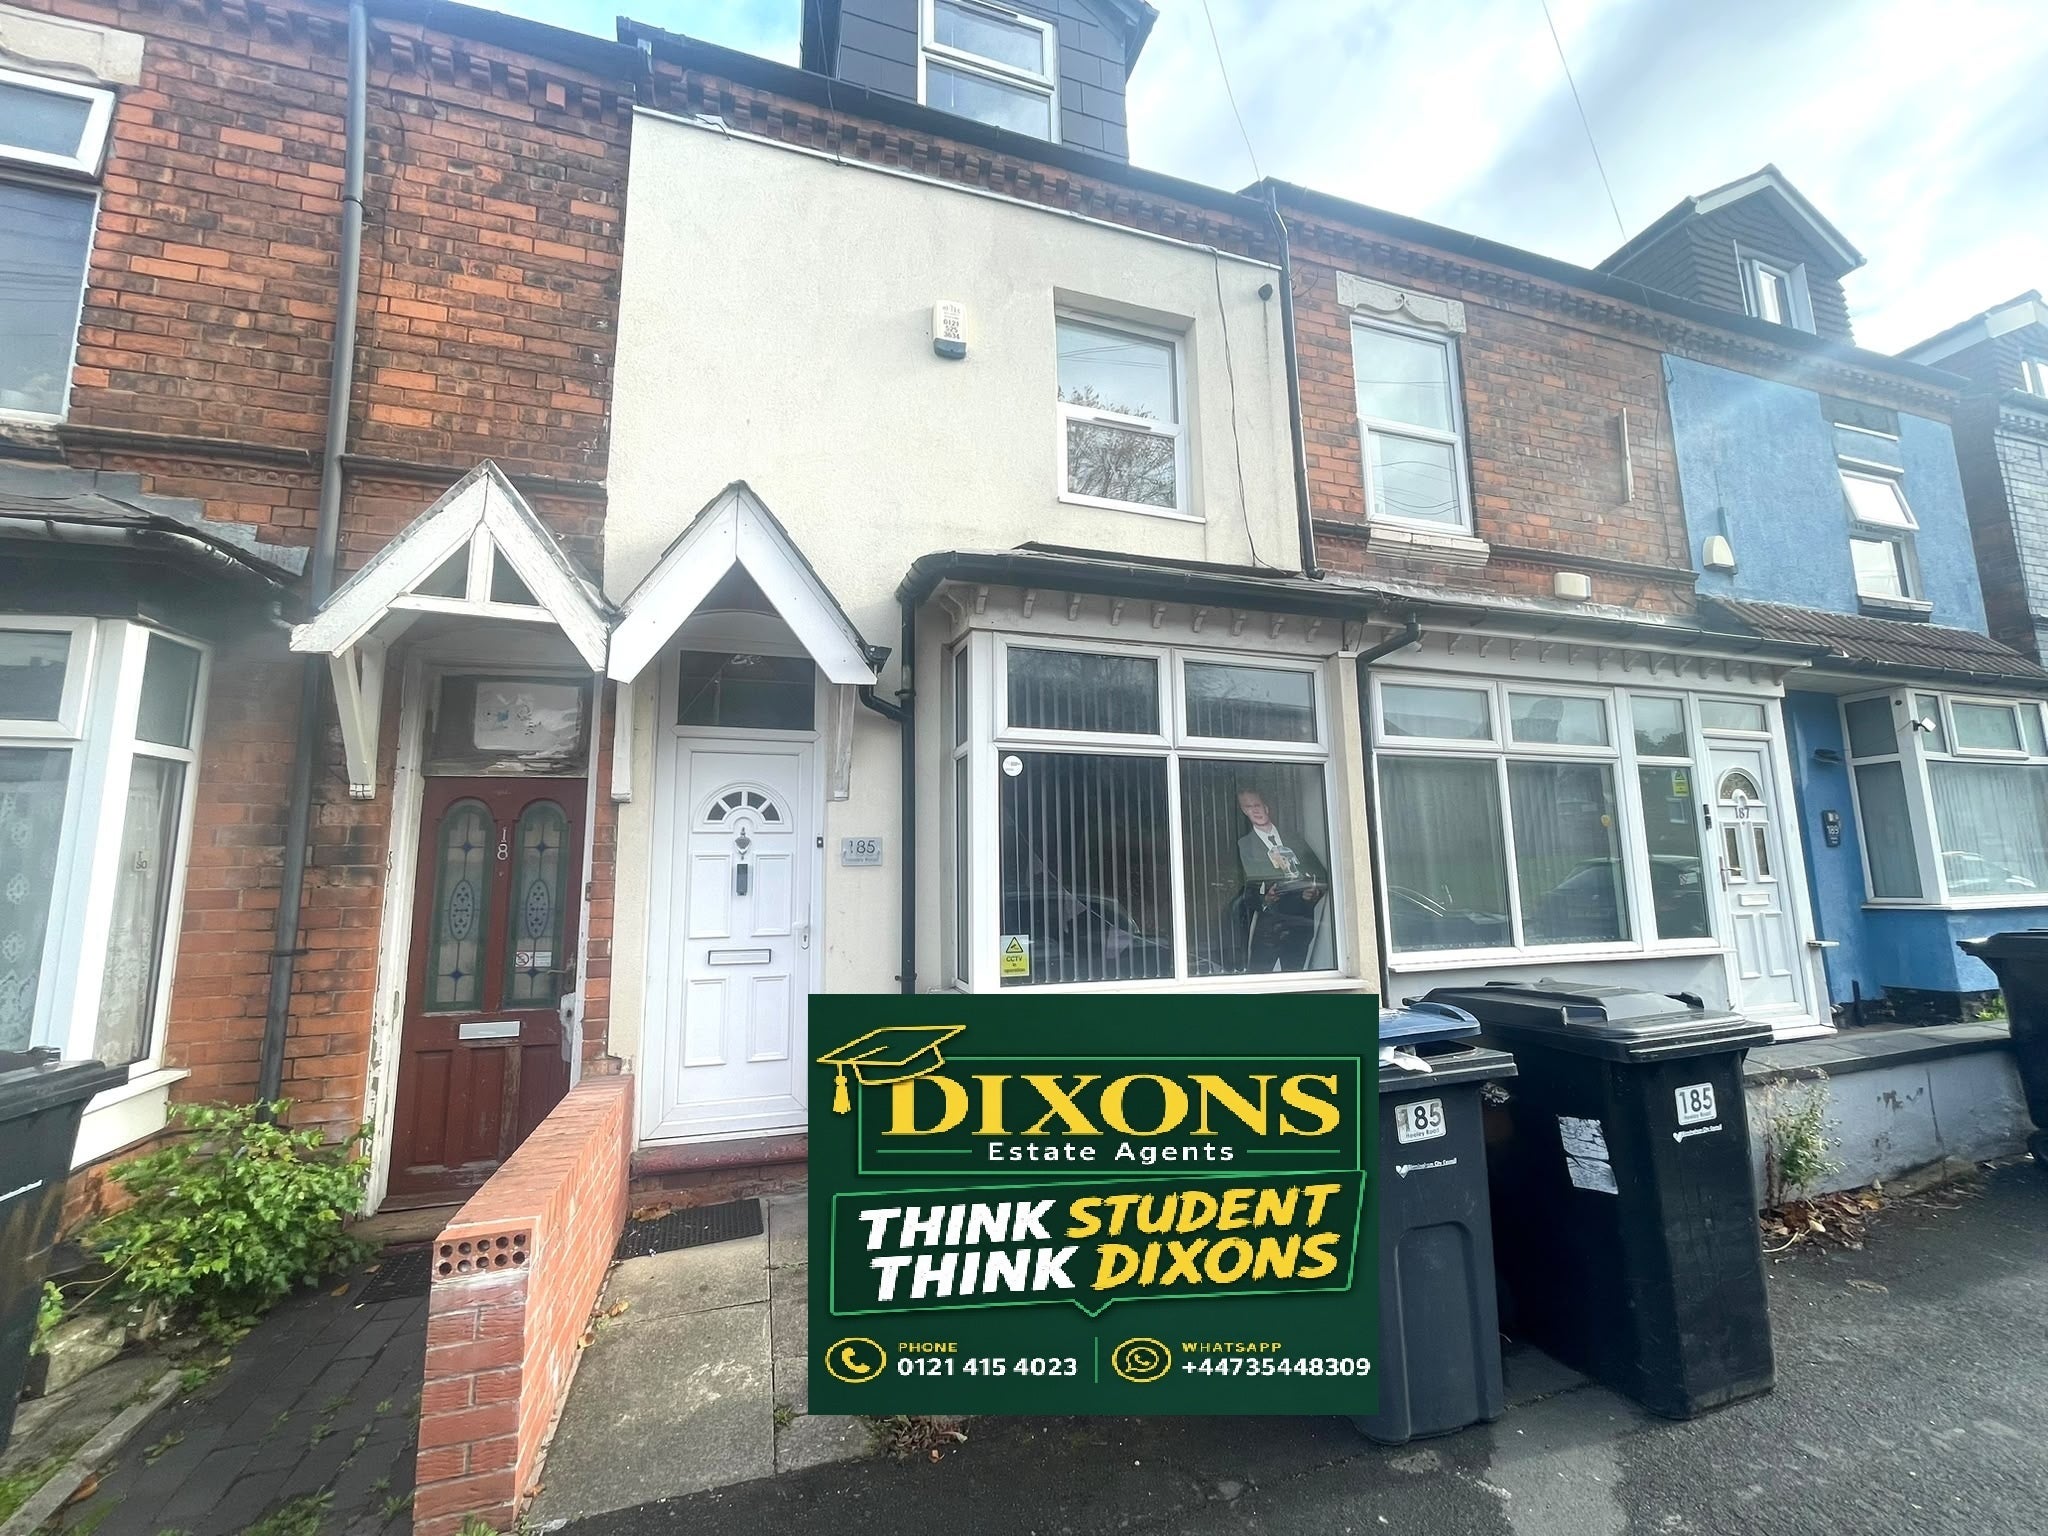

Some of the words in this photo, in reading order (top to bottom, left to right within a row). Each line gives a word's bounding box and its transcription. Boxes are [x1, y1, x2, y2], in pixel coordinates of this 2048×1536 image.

[1734, 807, 1749, 819] 187
[849, 840, 876, 854] 185
[1678, 1087, 1713, 1114] 185
[1399, 1102, 1441, 1131] 185
